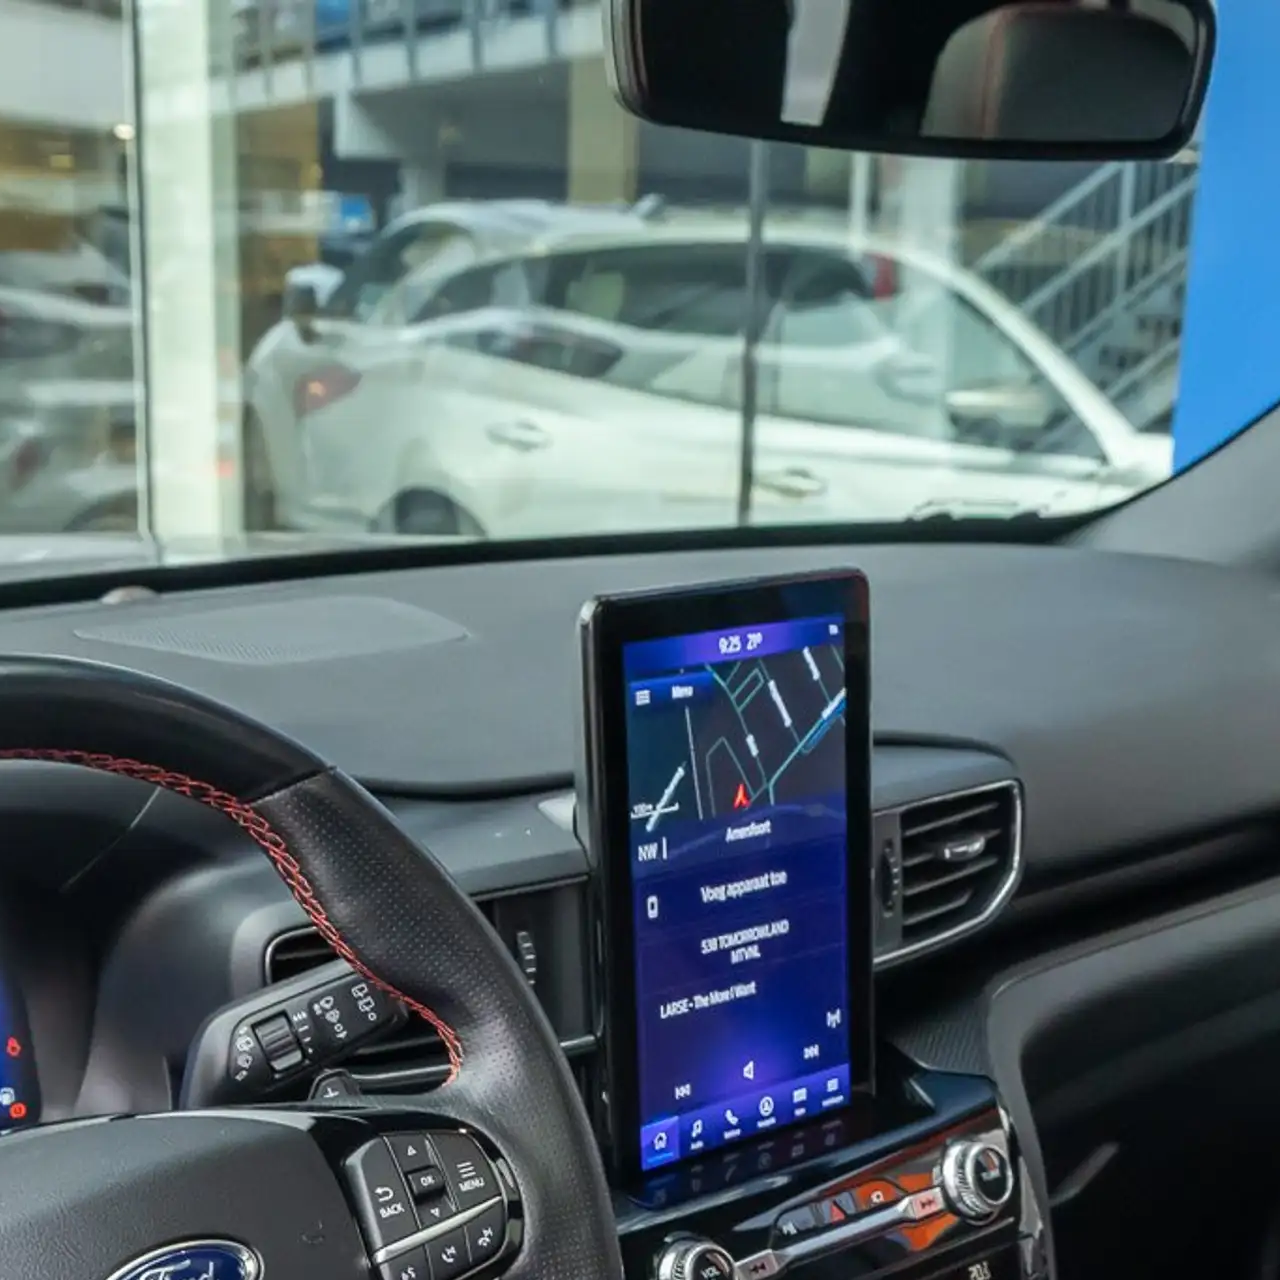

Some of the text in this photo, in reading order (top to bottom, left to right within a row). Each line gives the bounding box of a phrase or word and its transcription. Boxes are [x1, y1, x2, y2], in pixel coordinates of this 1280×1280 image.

[637, 842, 659, 861] NW
[769, 871, 788, 886] toe
[420, 1175, 437, 1187] OK
[458, 1177, 485, 1192] MENU
[380, 1203, 406, 1219] BACK
[700, 1266, 721, 1279] VOL
